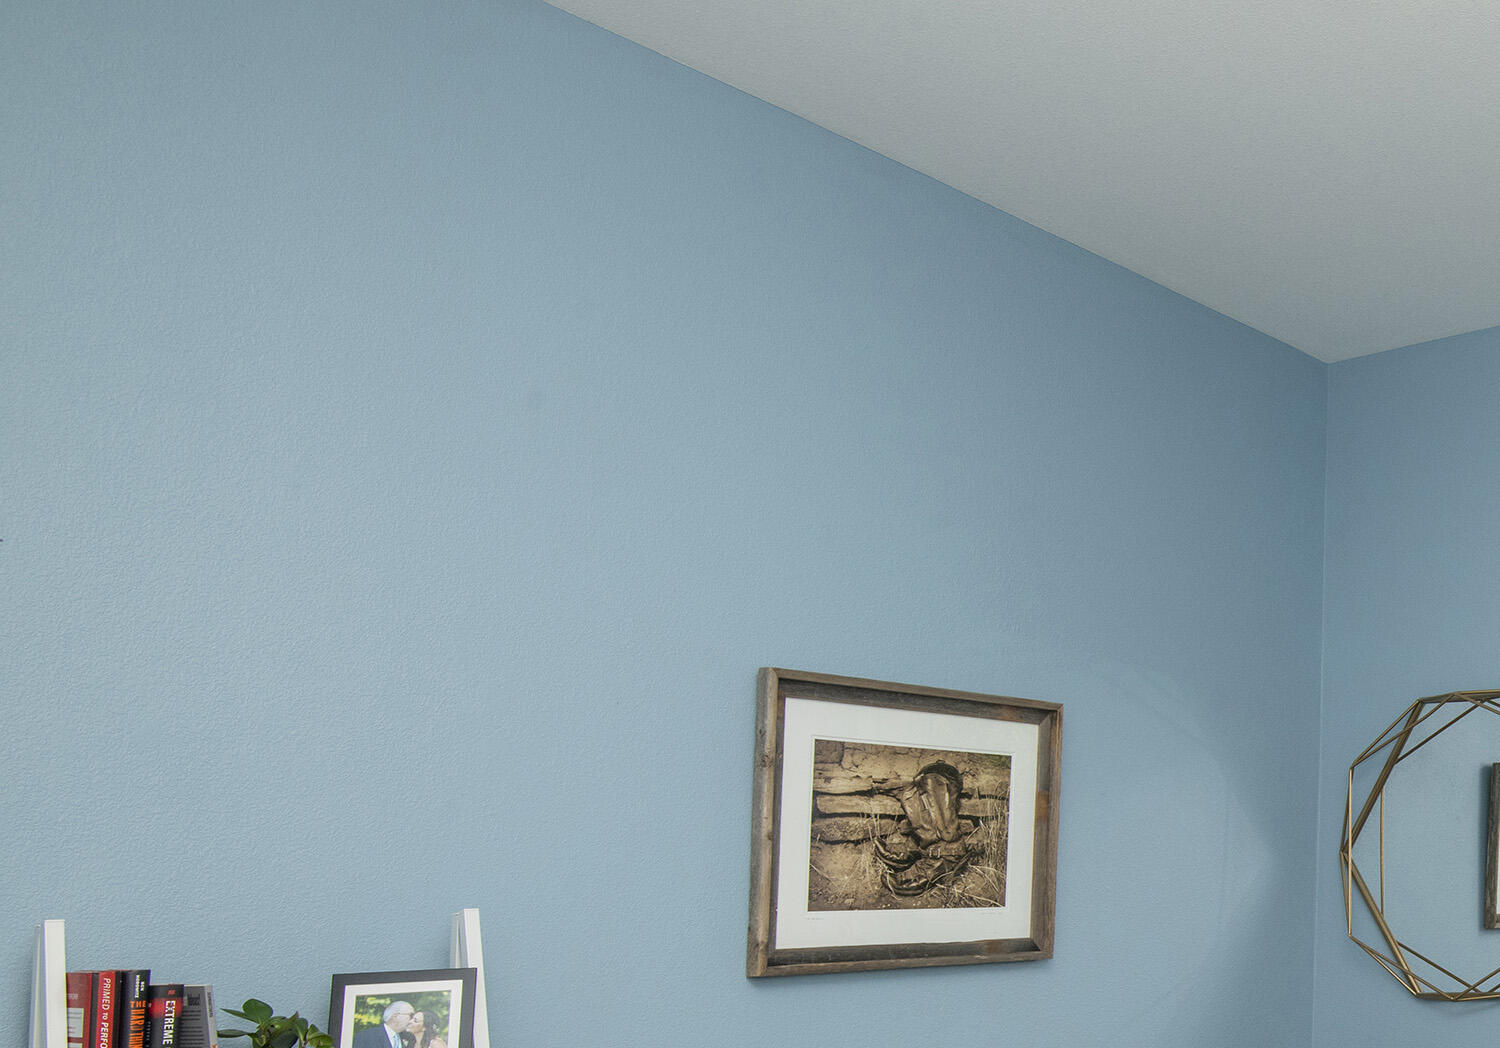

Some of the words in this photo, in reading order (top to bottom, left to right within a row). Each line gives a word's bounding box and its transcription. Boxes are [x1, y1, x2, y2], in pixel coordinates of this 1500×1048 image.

[102, 977, 111, 1010] PRIMED
[130, 1009, 145, 1031] HARD
[162, 1000, 175, 1045] EXTREME
